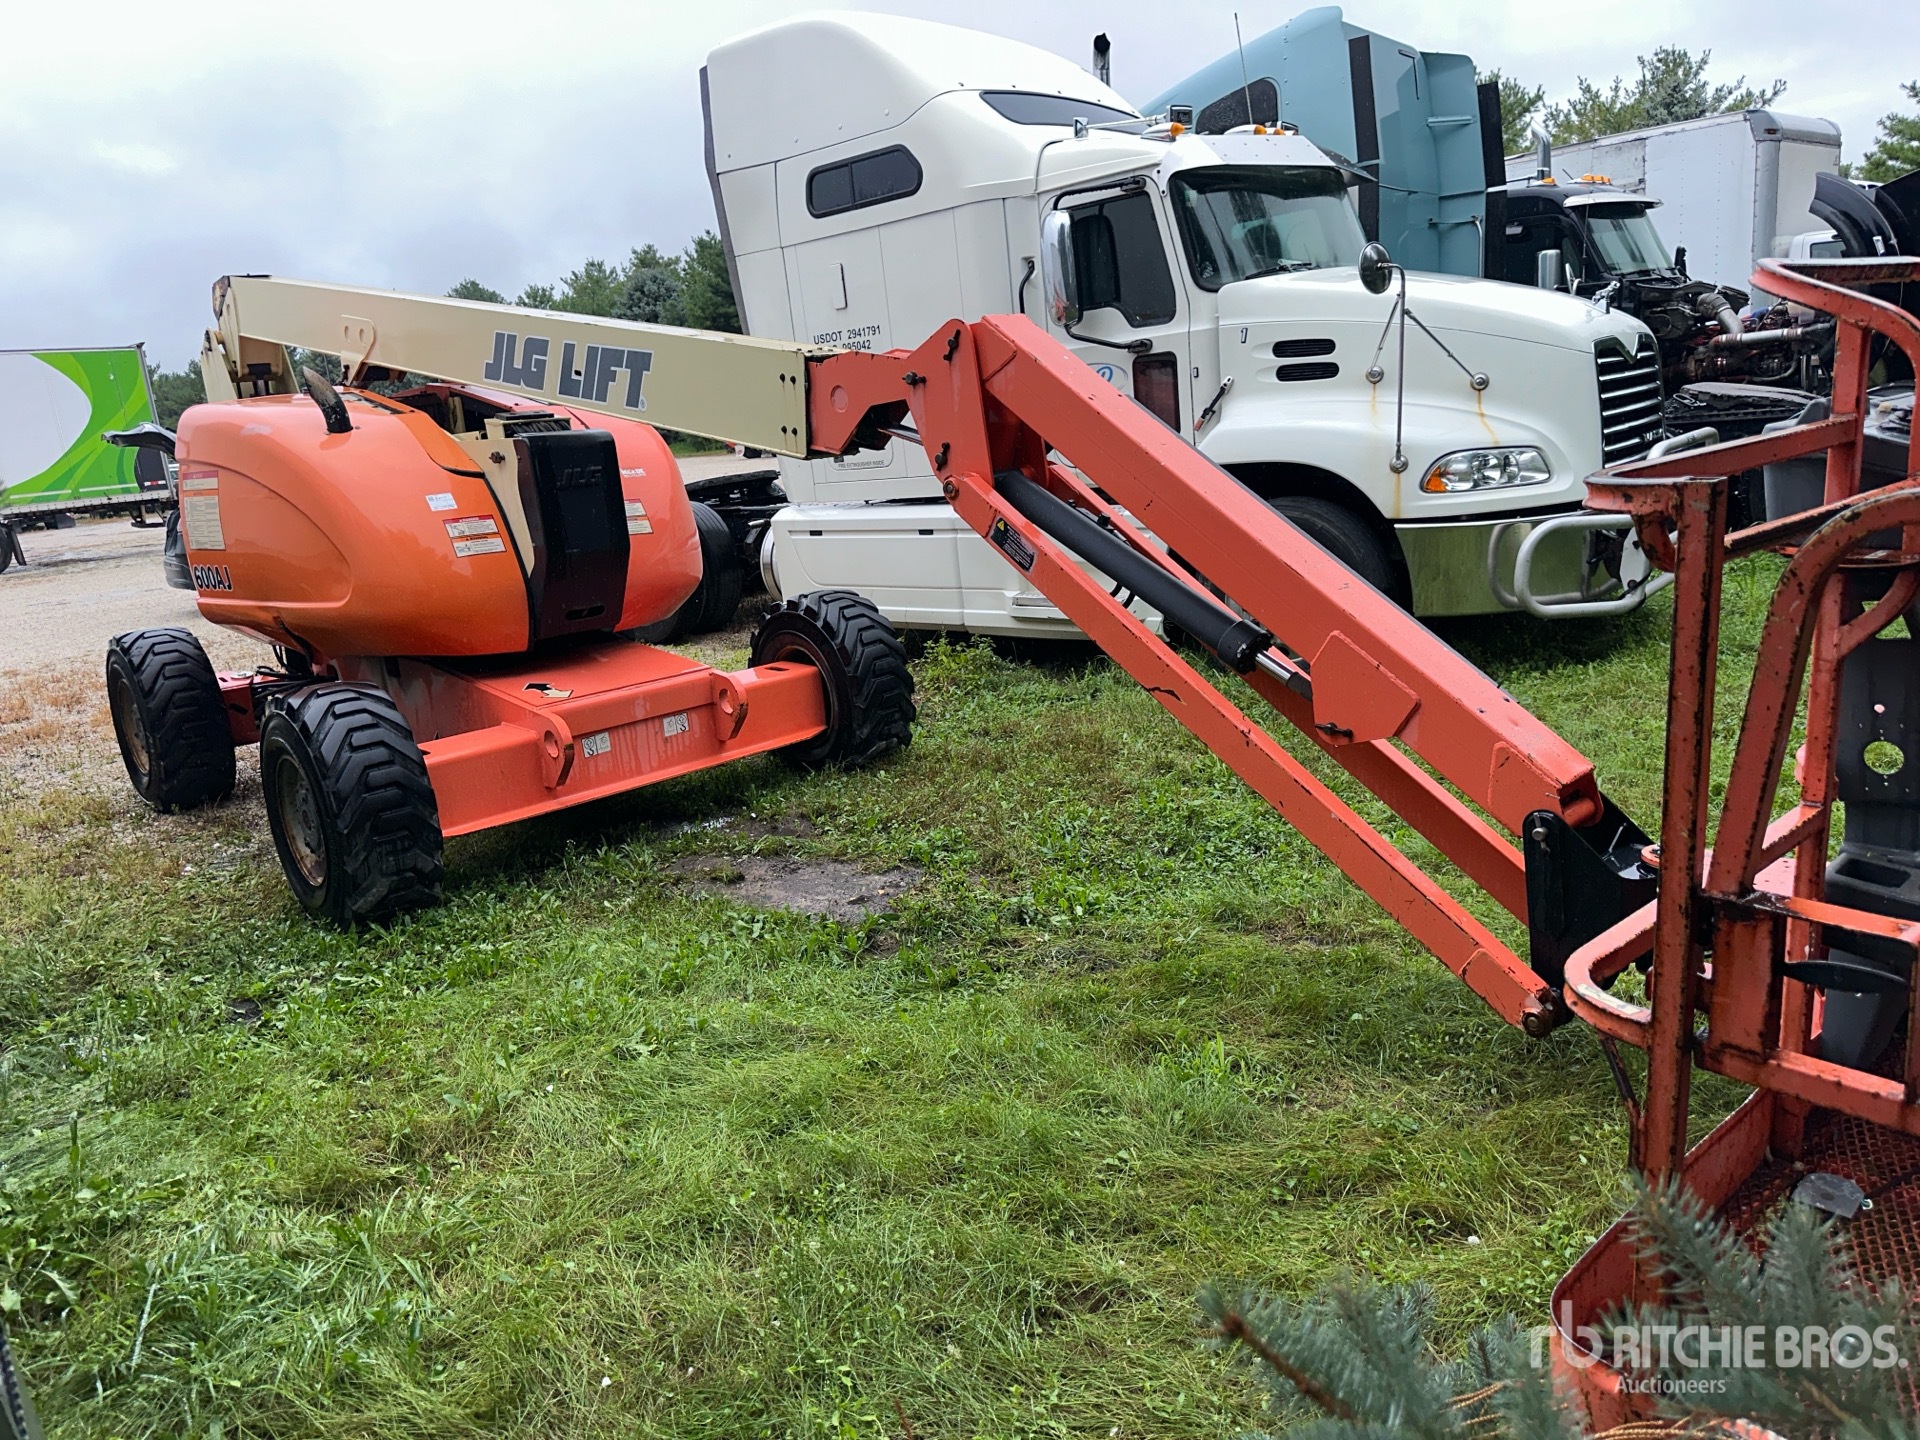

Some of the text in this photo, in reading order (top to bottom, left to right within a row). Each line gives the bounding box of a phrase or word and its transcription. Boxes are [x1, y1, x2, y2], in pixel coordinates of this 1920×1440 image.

[813, 324, 881, 345] USDOT 2941791
[483, 330, 656, 411] JLG LIFT
[557, 466, 602, 487] JLG
[193, 565, 233, 591] 600AJ
